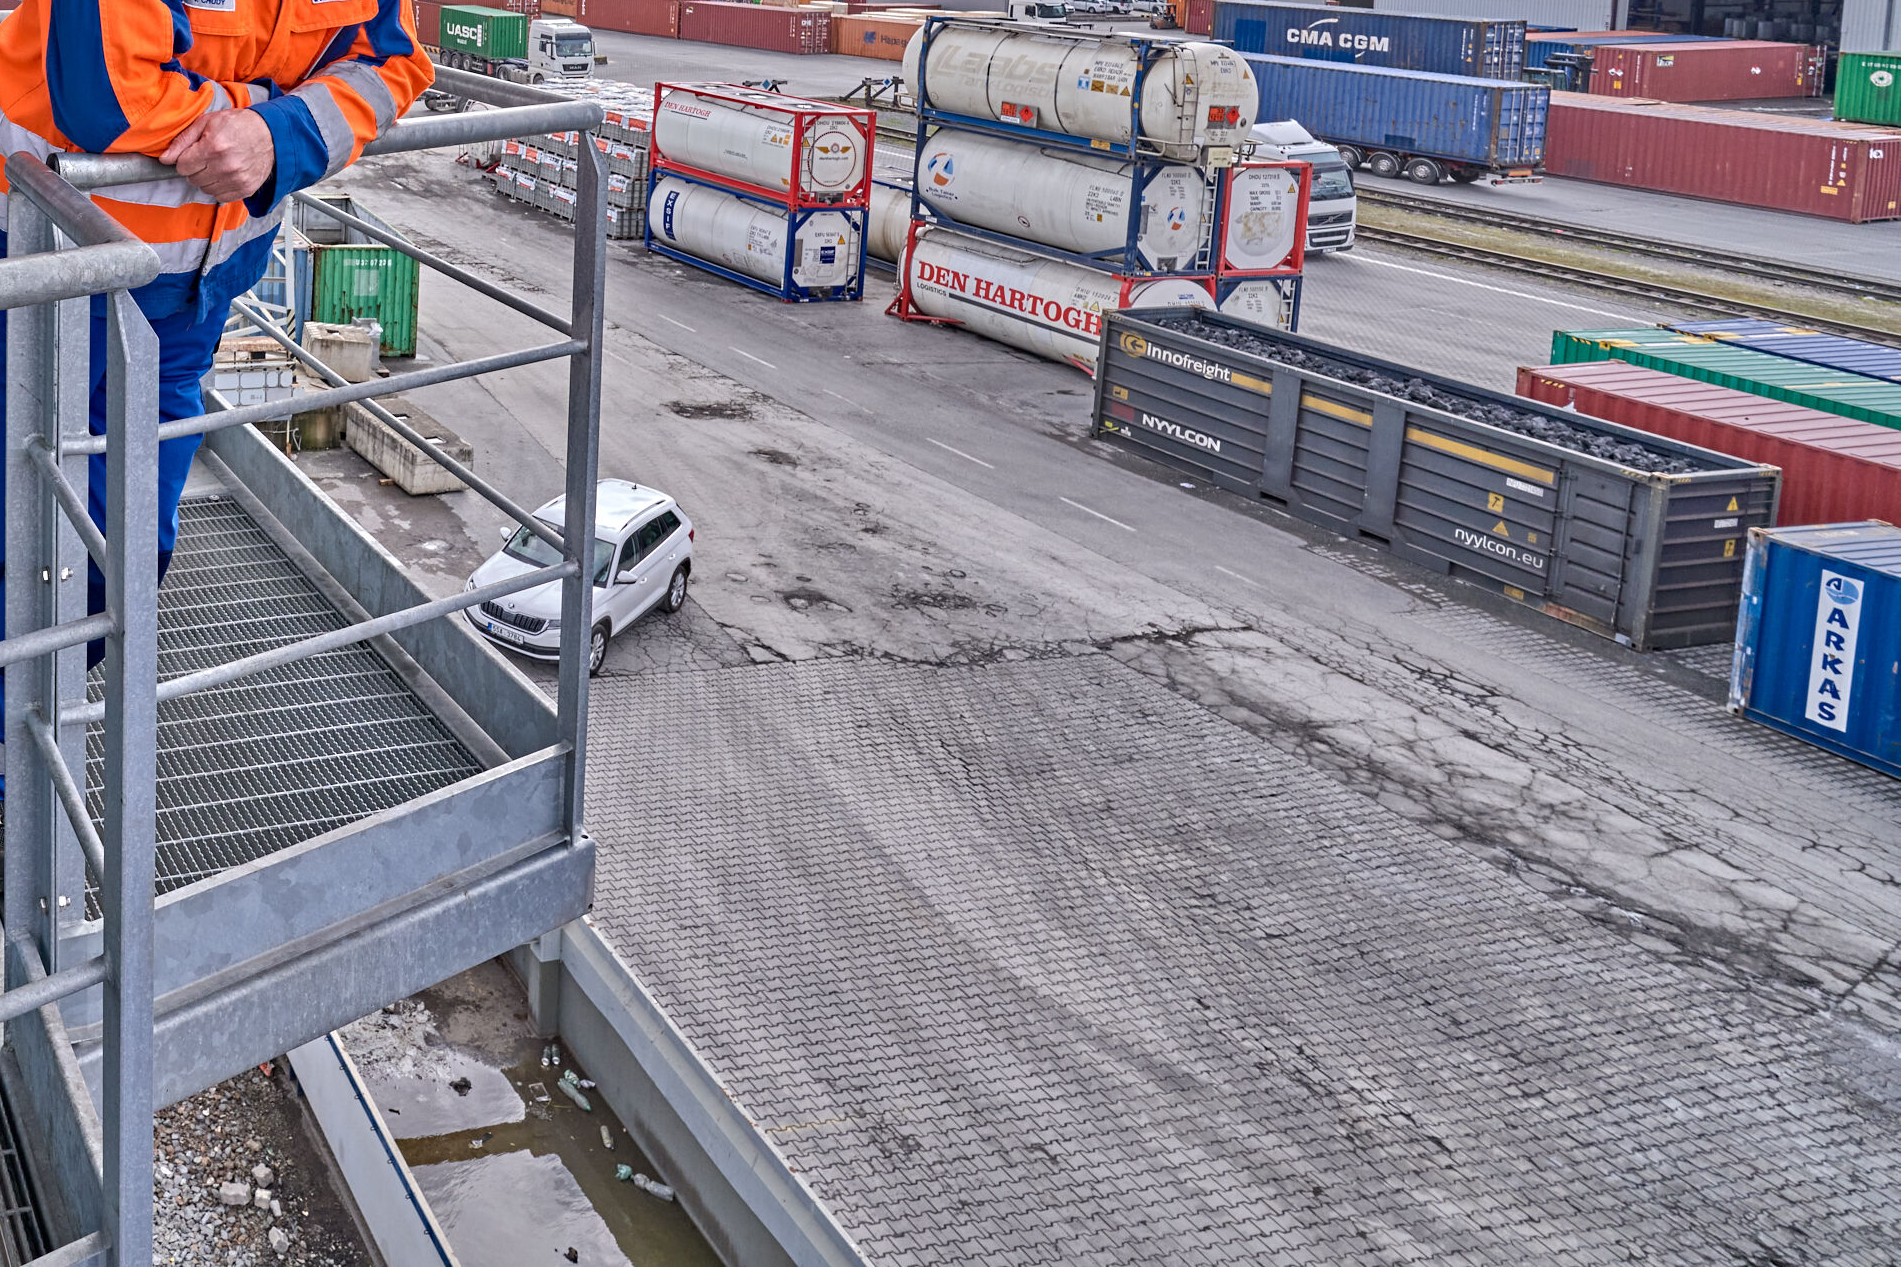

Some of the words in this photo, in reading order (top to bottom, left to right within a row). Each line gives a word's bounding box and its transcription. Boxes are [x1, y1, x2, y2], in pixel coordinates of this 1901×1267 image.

[446, 22, 477, 41] UASC
[1286, 27, 1333, 48] CMA
[1338, 33, 1390, 53] CGM
[664, 100, 677, 111] DEN
[678, 103, 712, 118] HARTOGH
[664, 192, 677, 230] EXSIF
[916, 282, 947, 297] LOGISTICS
[917, 260, 969, 299] DEN
[972, 276, 1102, 337] HARTOGH
[1141, 413, 1221, 453] NYYLCON
[1454, 527, 1544, 569] nyylcon.eu
[1817, 607, 1850, 722] ARKAS
